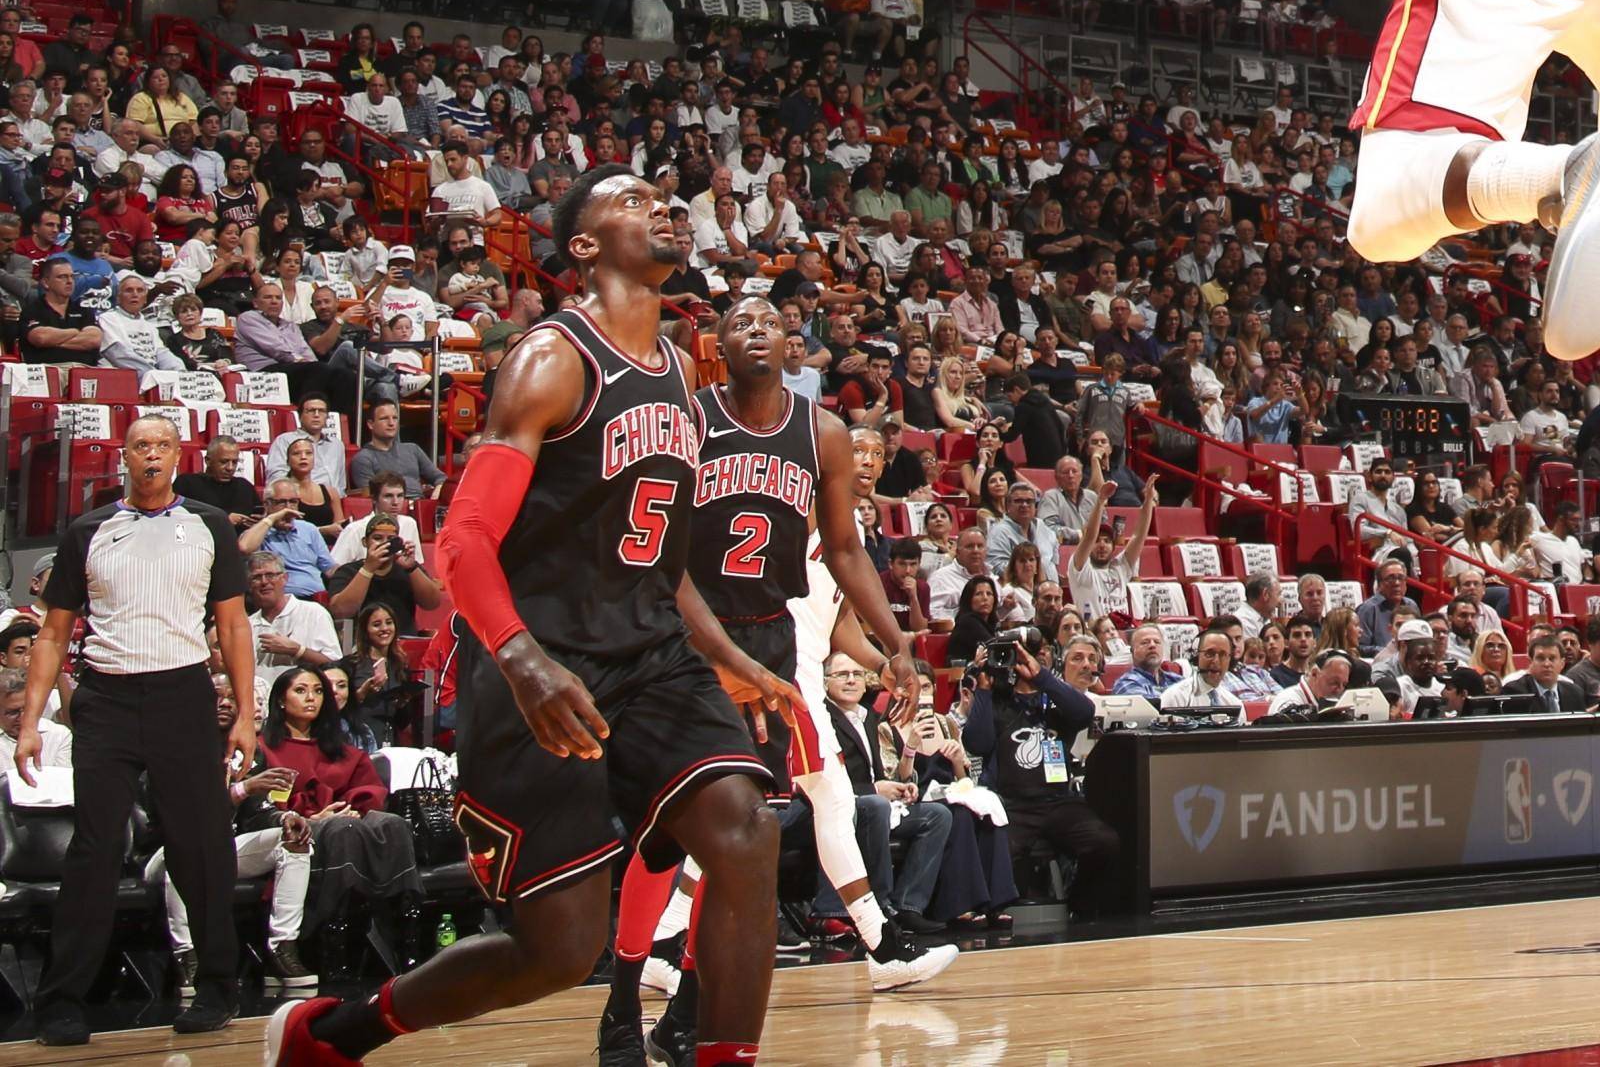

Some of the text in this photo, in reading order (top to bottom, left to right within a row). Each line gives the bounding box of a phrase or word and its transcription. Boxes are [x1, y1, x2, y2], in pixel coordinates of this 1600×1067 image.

[1443, 443, 1463, 453] BULLS
[694, 453, 812, 517] CHICAGO
[619, 478, 677, 566] 5
[722, 512, 772, 579] 2
[1240, 784, 1446, 840] FANDUEL
